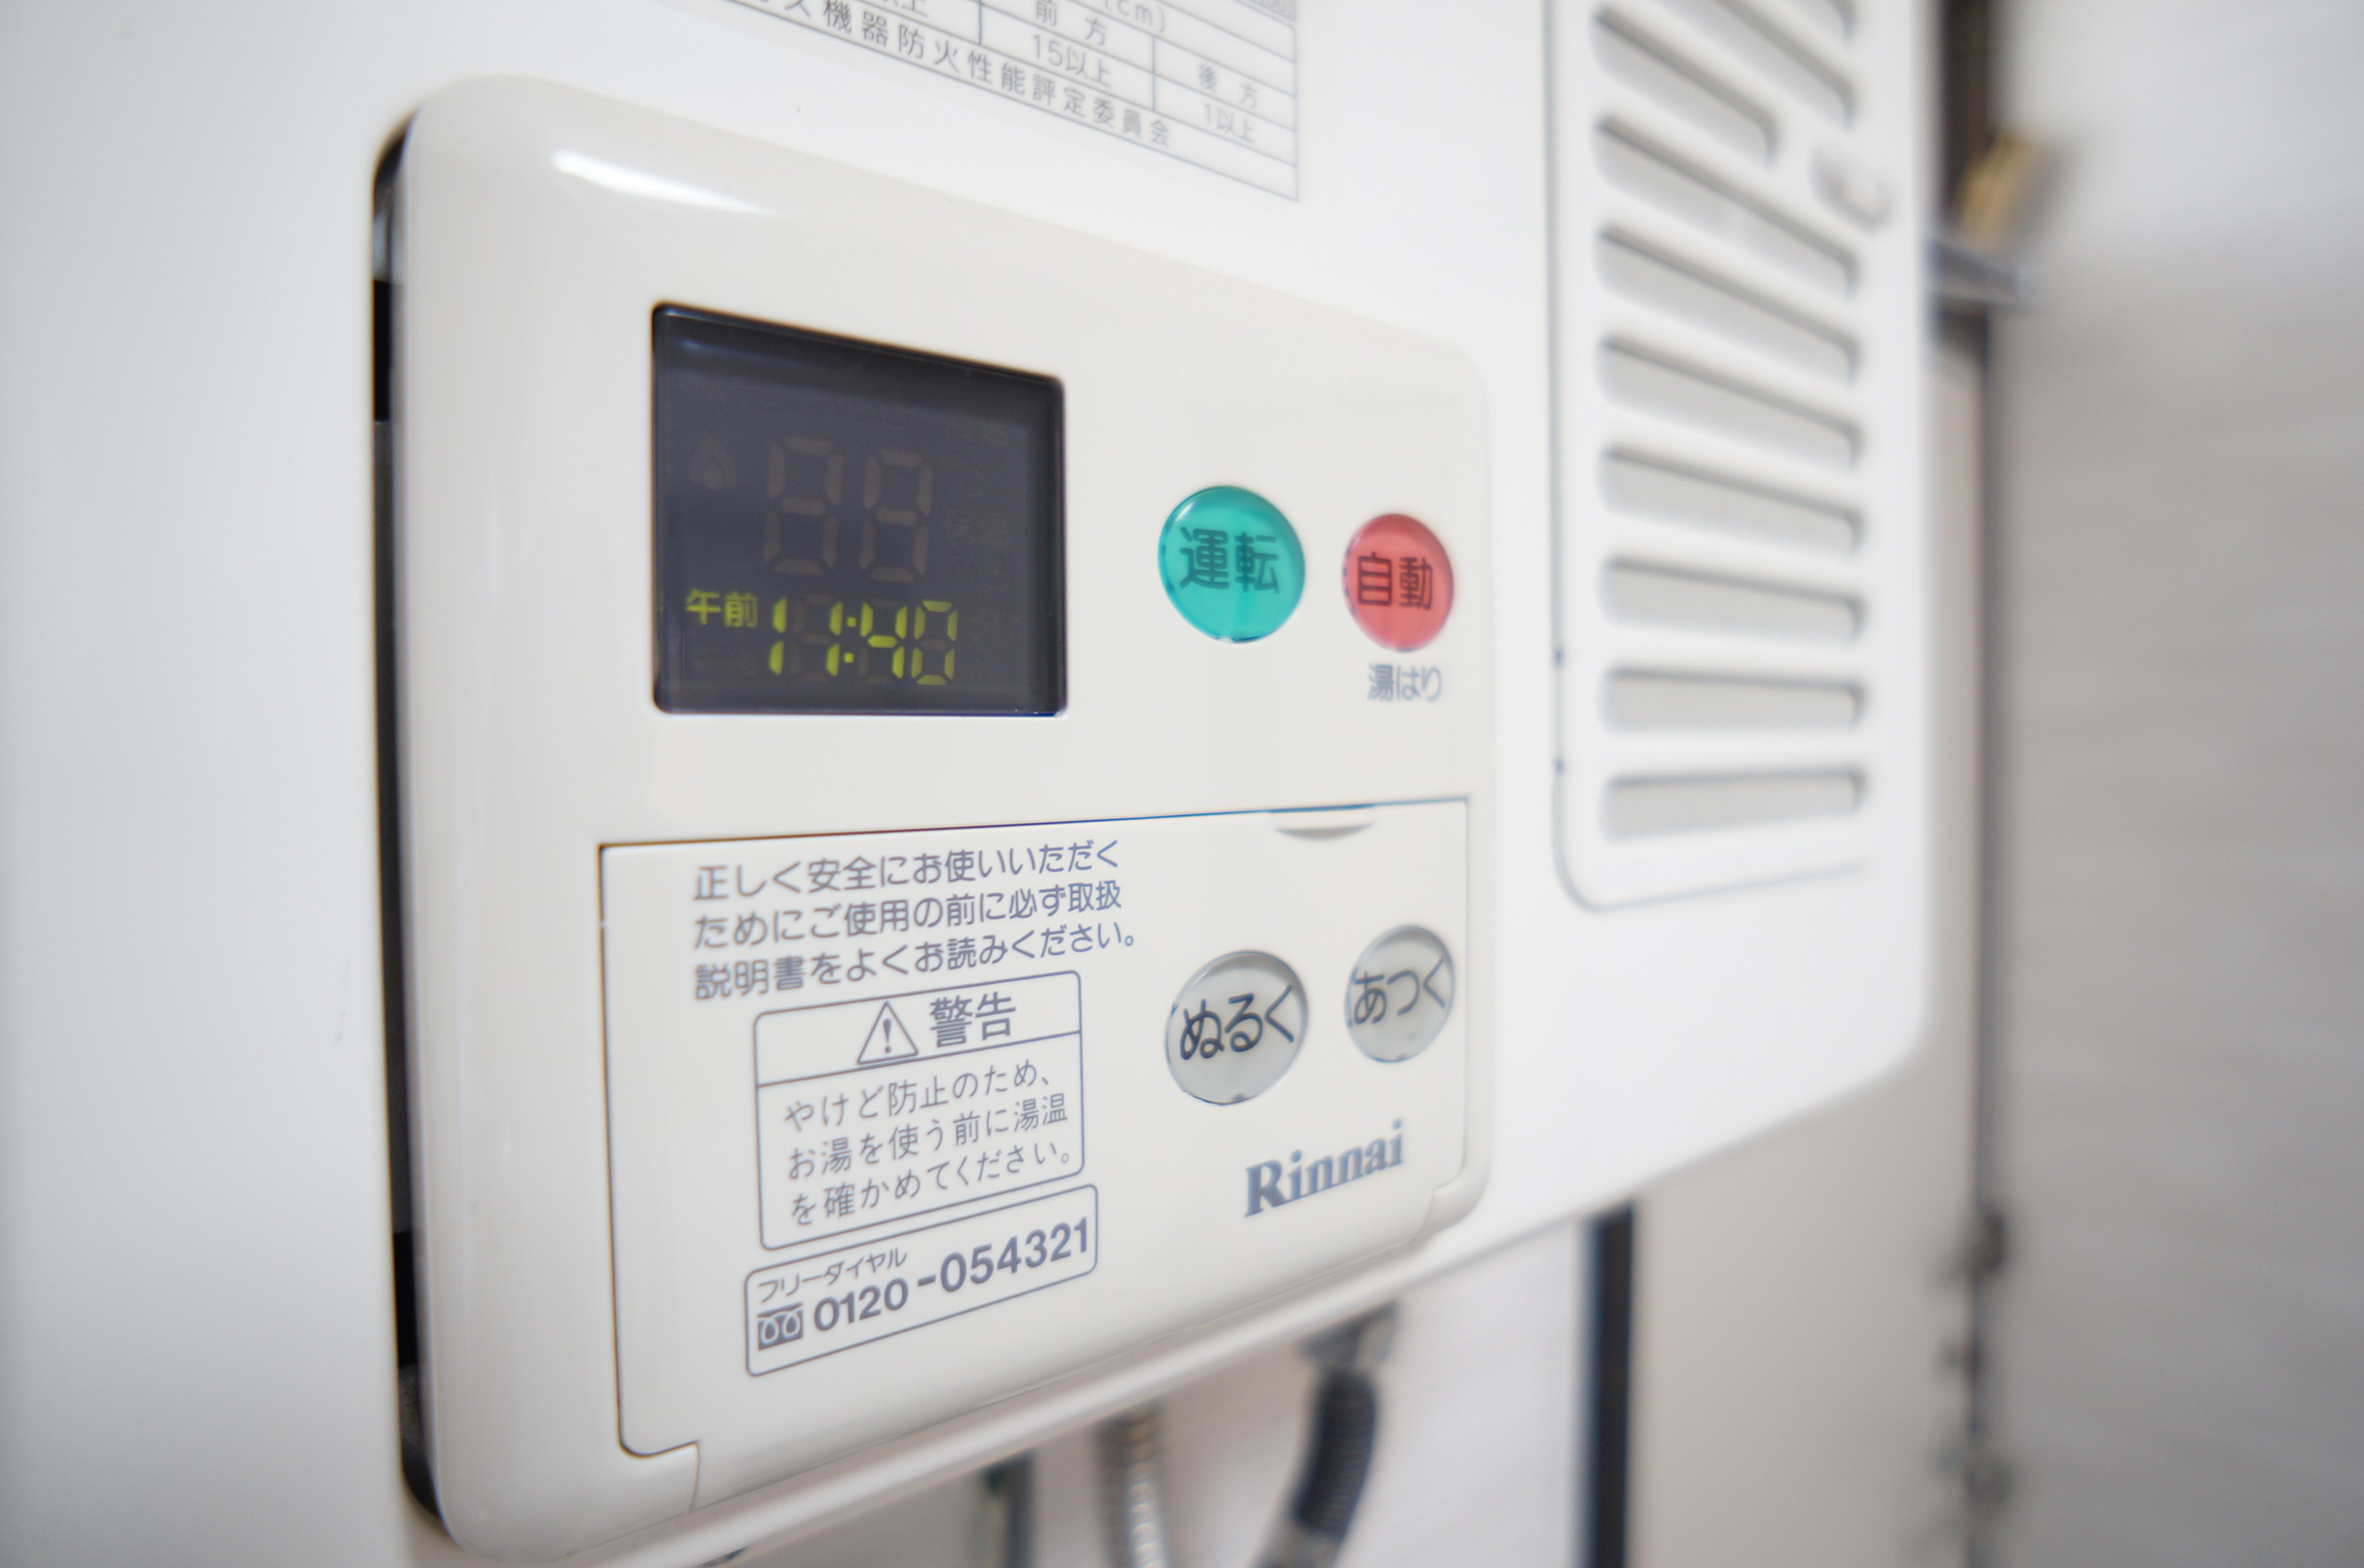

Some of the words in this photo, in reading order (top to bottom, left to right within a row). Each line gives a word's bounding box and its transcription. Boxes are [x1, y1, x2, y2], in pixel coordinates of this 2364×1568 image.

[760, 0, 1169, 147] ス機器防火性能評定委員会
[1033, 34, 1111, 88] 15以上
[1204, 102, 1255, 144] 1以上
[1179, 526, 1280, 594] 運転
[1357, 551, 1434, 610] 自動
[686, 589, 758, 629] 午前
[769, 598, 958, 686] 11:40
[1367, 662, 1443, 703] 湯はり
[693, 839, 1120, 901] 正しく安全にお使いいただく
[693, 880, 1122, 950] ためにご使用の前に必ず取扱
[693, 921, 1135, 1000] 説明書をよくお読みください。
[1353, 952, 1448, 1025] あつく
[929, 991, 1017, 1049] 警告
[1180, 983, 1295, 1061] ぬるく
[784, 1058, 1051, 1133] やけど防止のため、
[788, 1092, 1069, 1180] お湯を使う前に湯温
[1244, 1117, 1404, 1218] Rinnai
[791, 1139, 1071, 1226] を確かめてください。
[758, 1246, 909, 1303] フリーダイヤル
